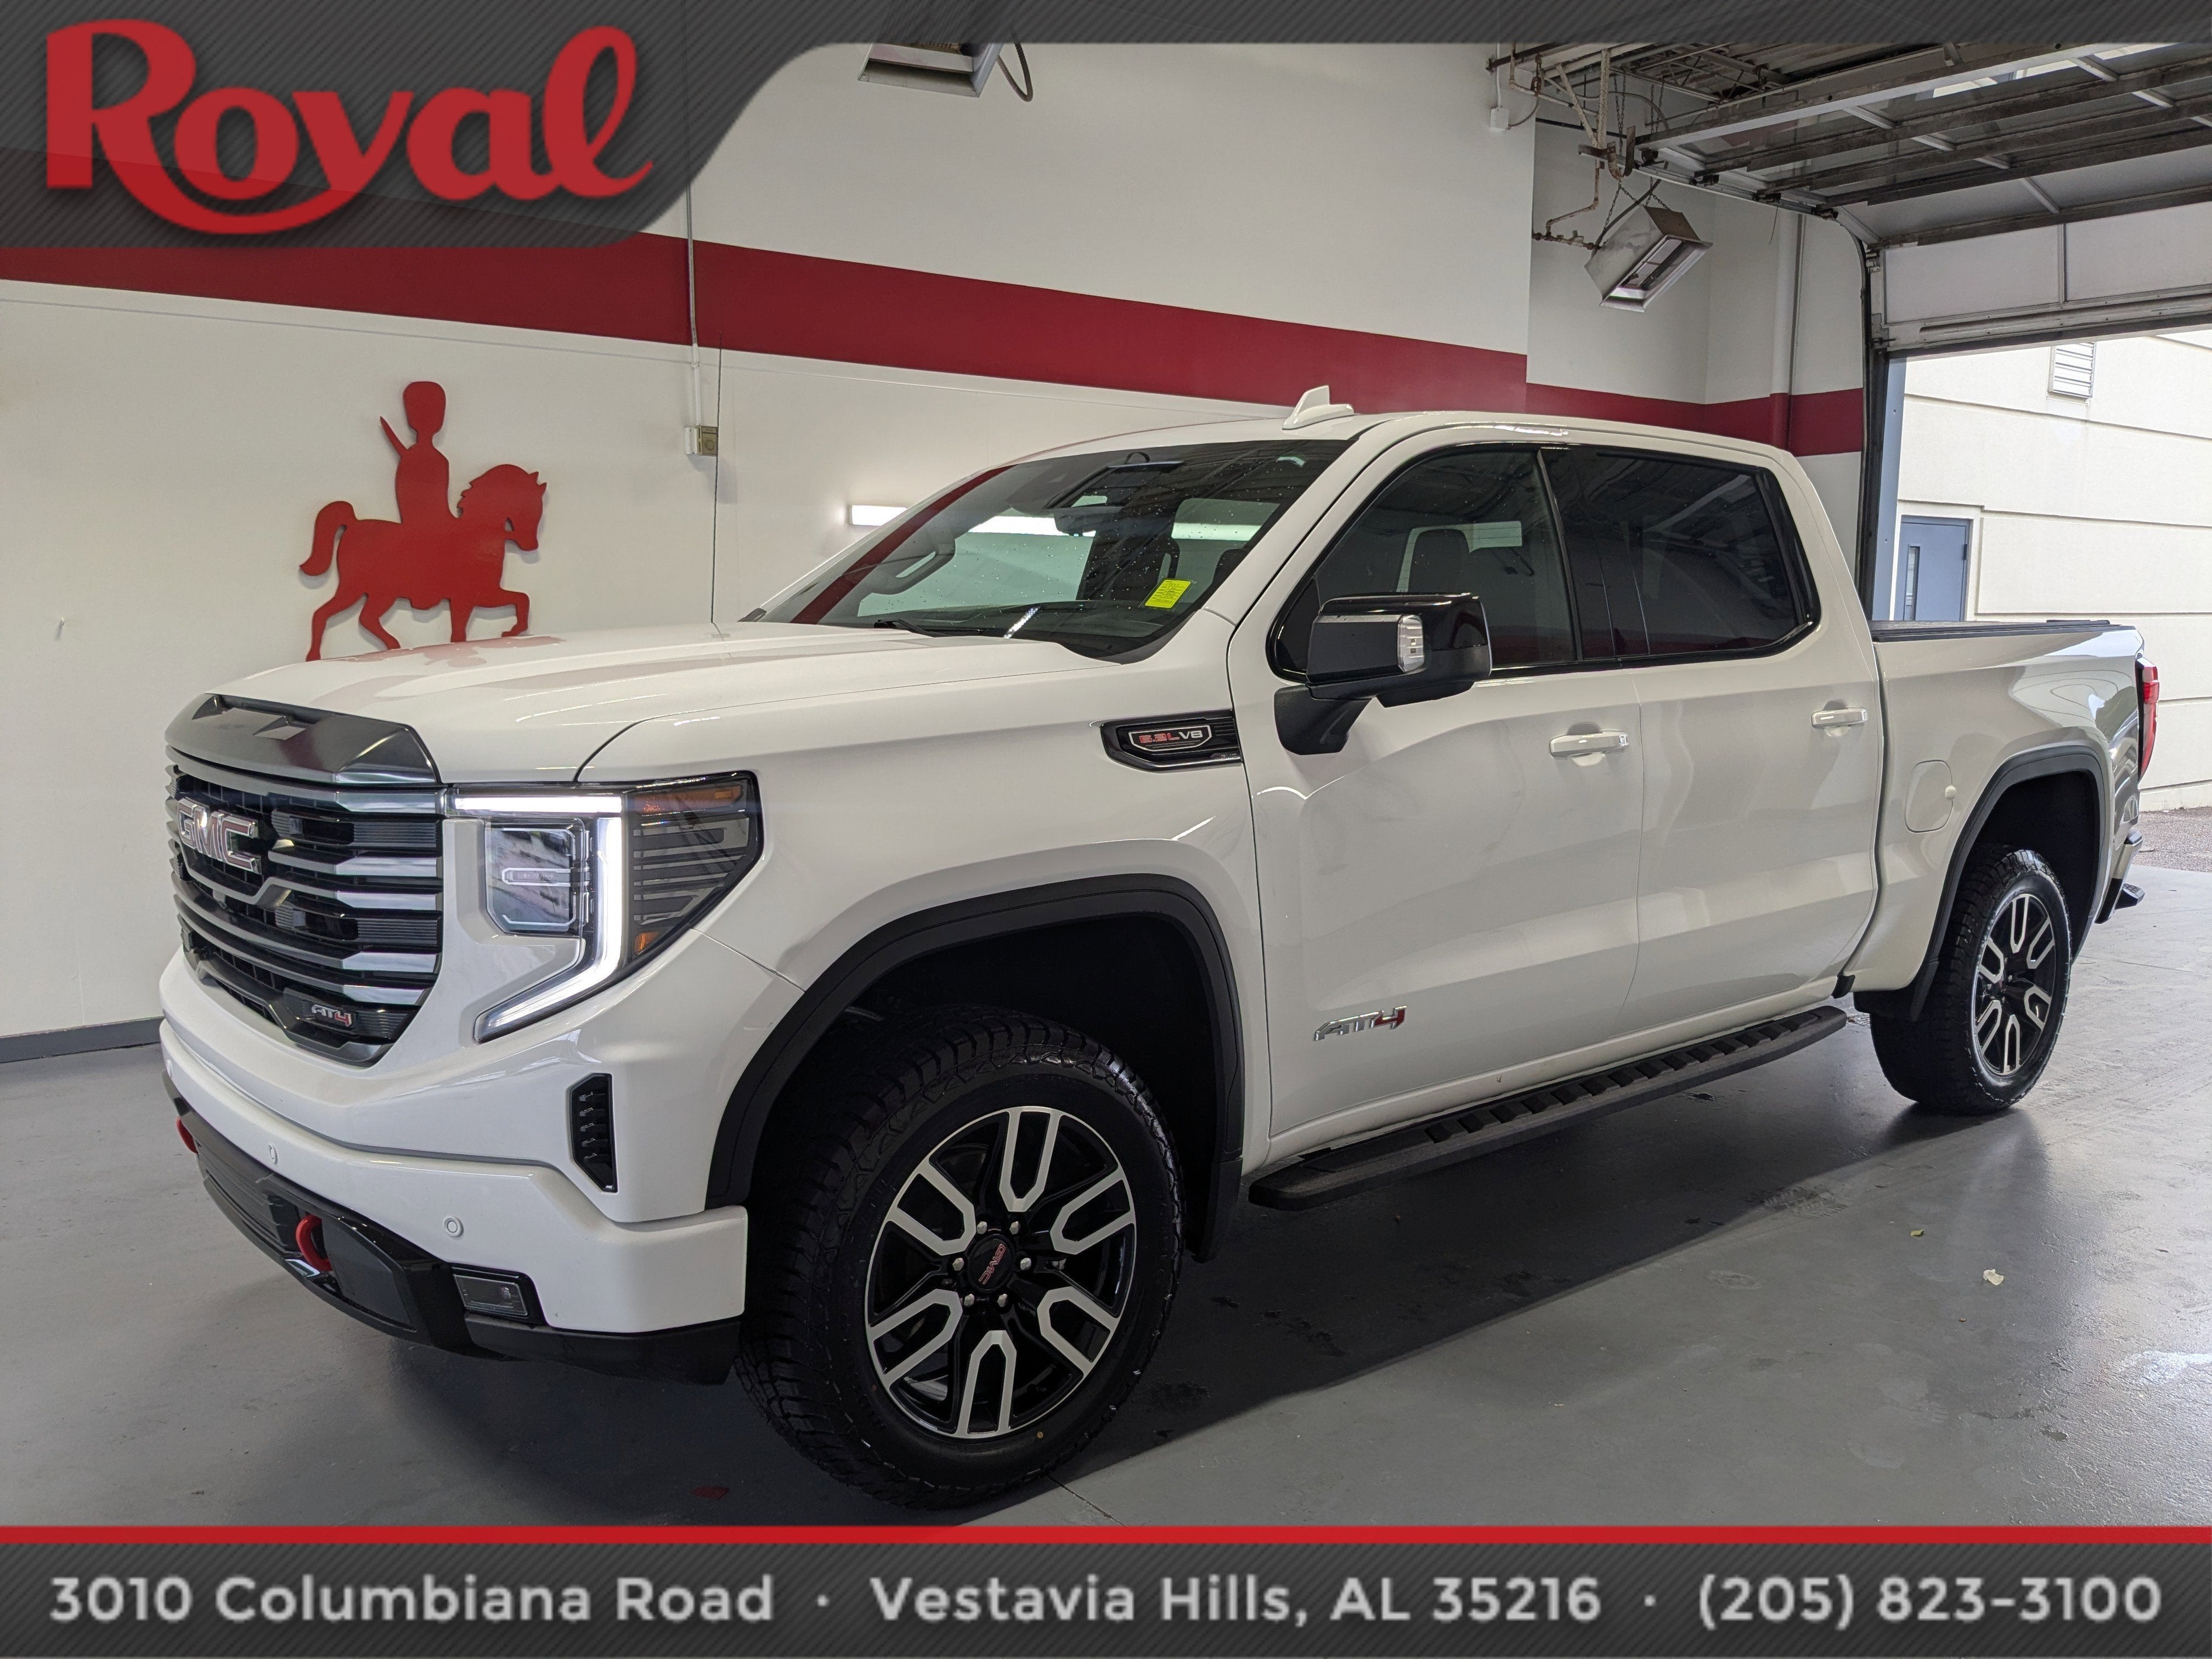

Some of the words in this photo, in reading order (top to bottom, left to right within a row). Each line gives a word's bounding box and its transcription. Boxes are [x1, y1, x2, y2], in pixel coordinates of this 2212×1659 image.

[177, 797, 263, 874] GMC
[311, 1004, 352, 1027] AT4
[1314, 1005, 1407, 1041] AT4
[978, 1243, 1006, 1285] GMC
